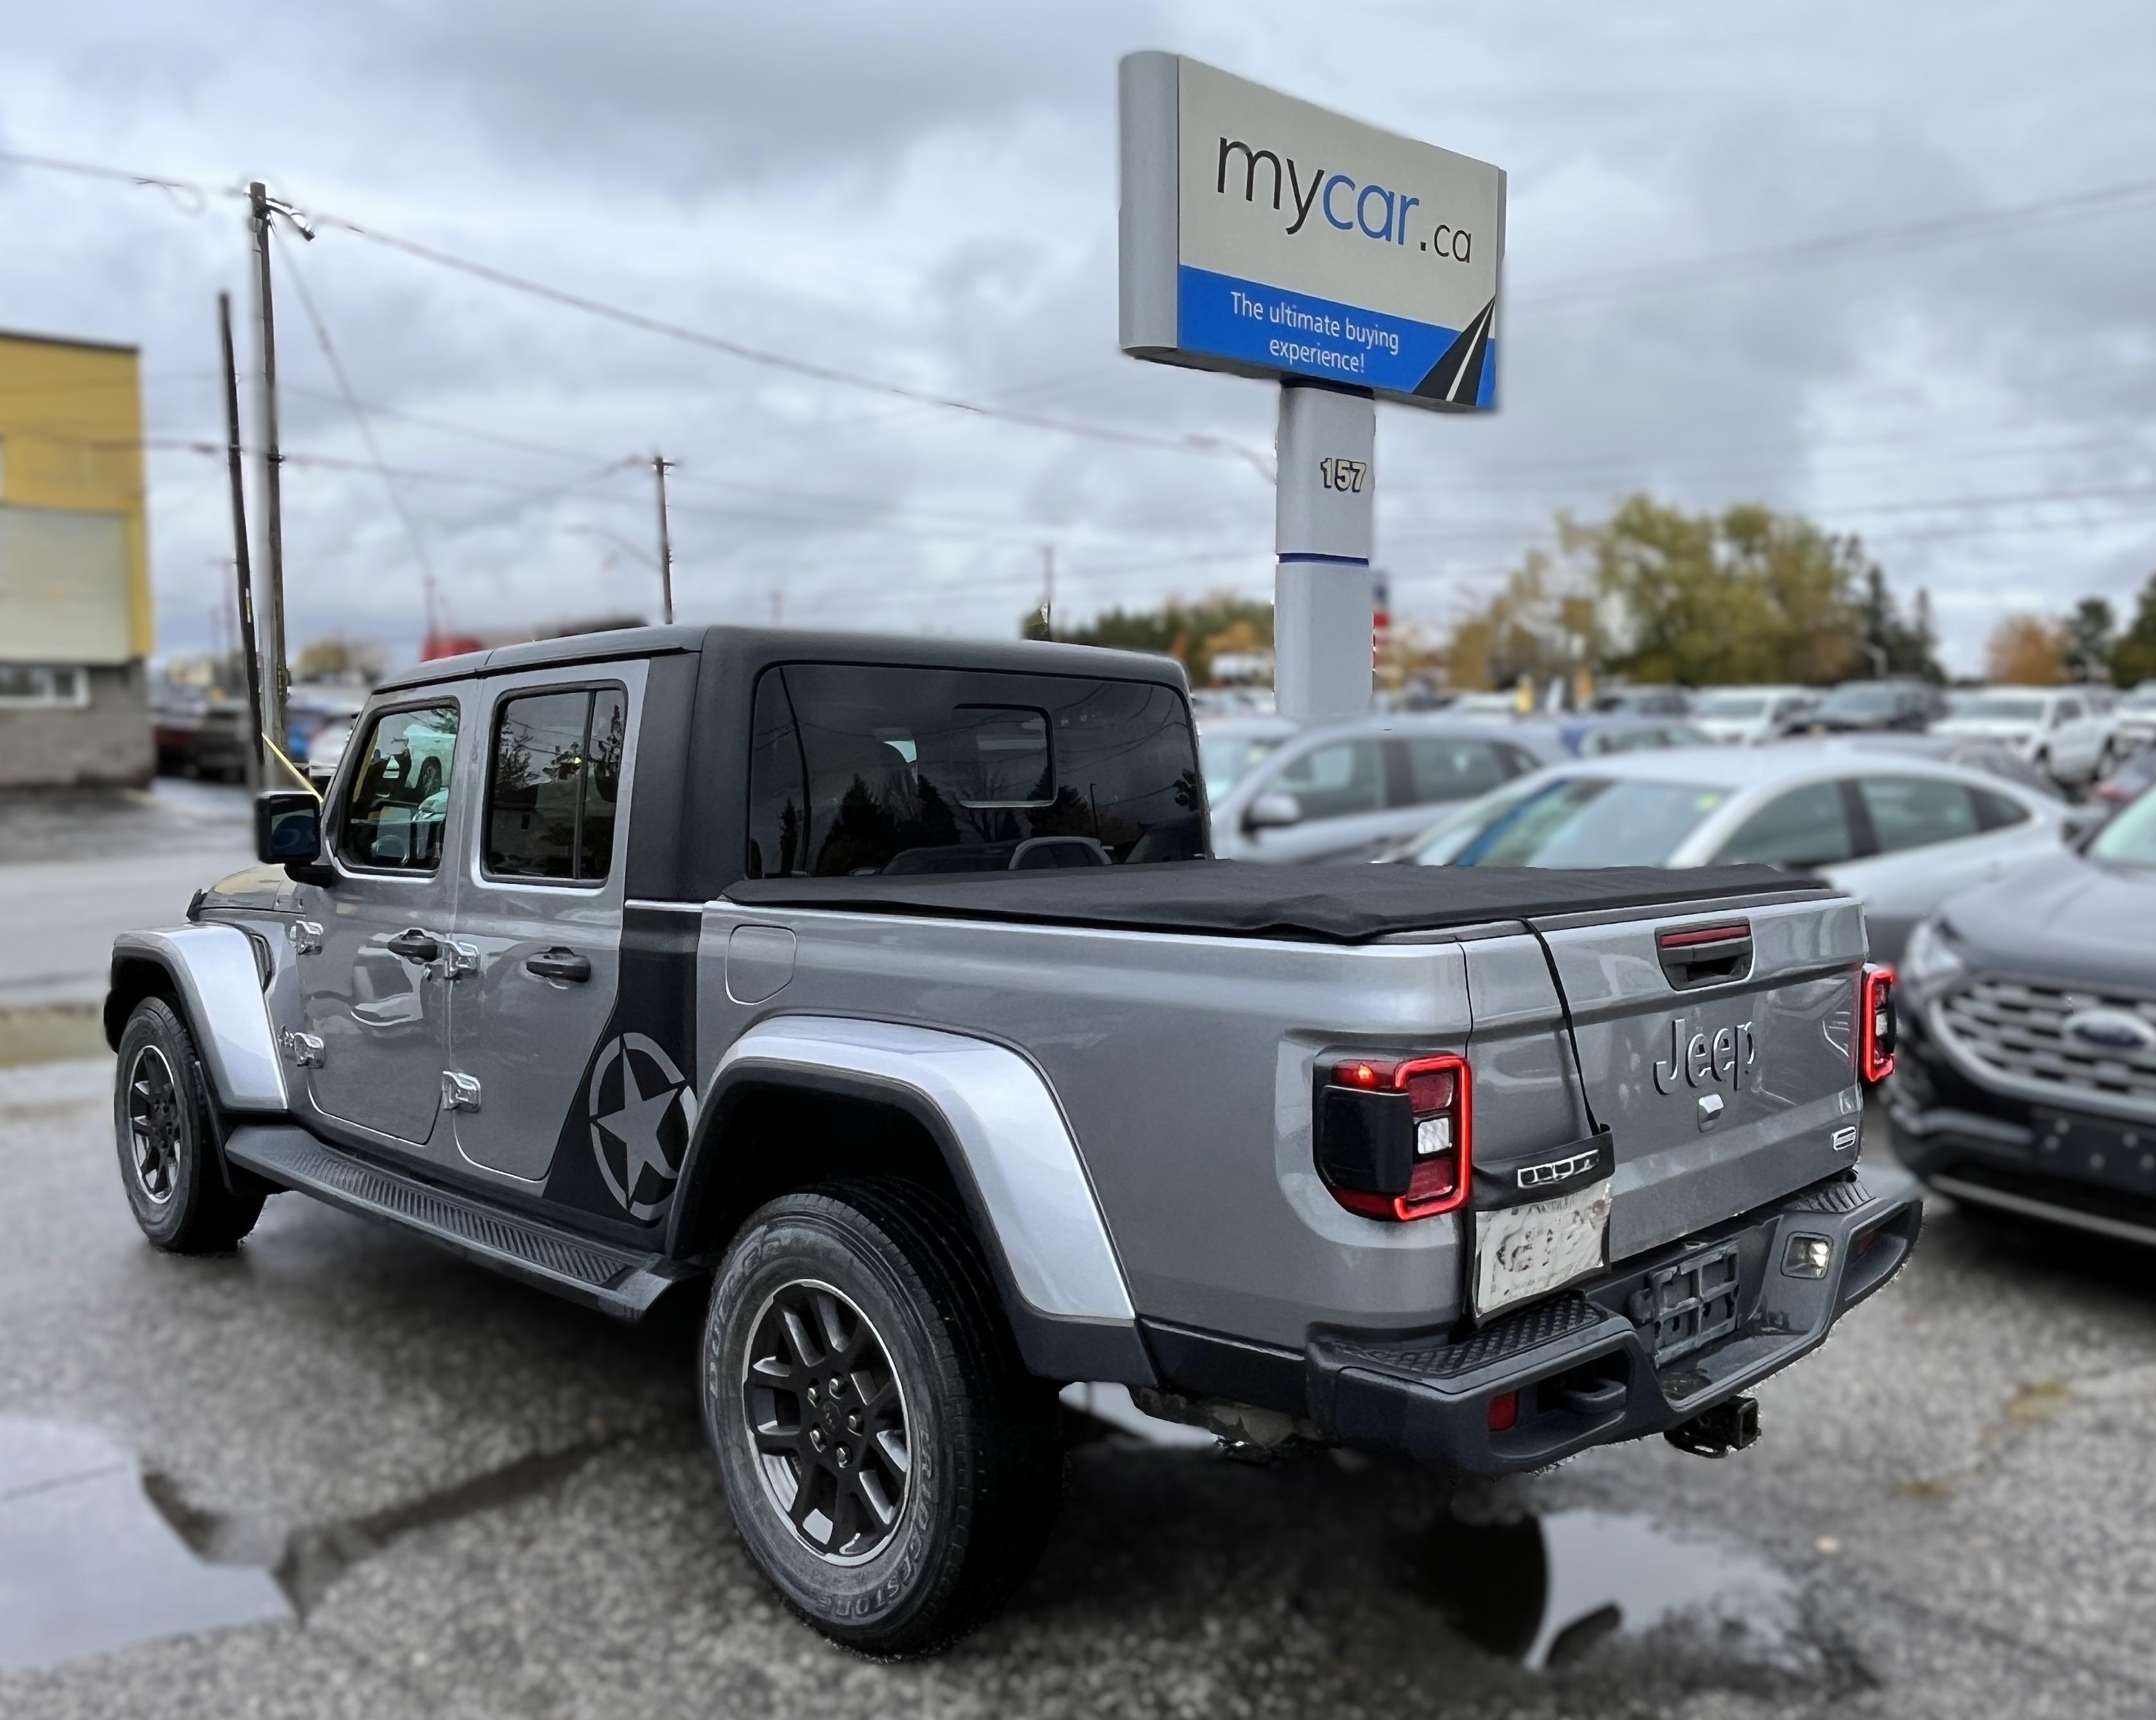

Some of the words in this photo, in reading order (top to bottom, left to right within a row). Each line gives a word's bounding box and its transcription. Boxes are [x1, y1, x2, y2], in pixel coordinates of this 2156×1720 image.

[1217, 136, 1472, 264] mycar.ca
[1230, 291, 1264, 320] The
[1269, 301, 1340, 338] ultimate
[1346, 318, 1399, 356] buying
[1269, 338, 1365, 374] experience!
[1319, 457, 1367, 493] 157
[1653, 1018, 1756, 1095] Jeep
